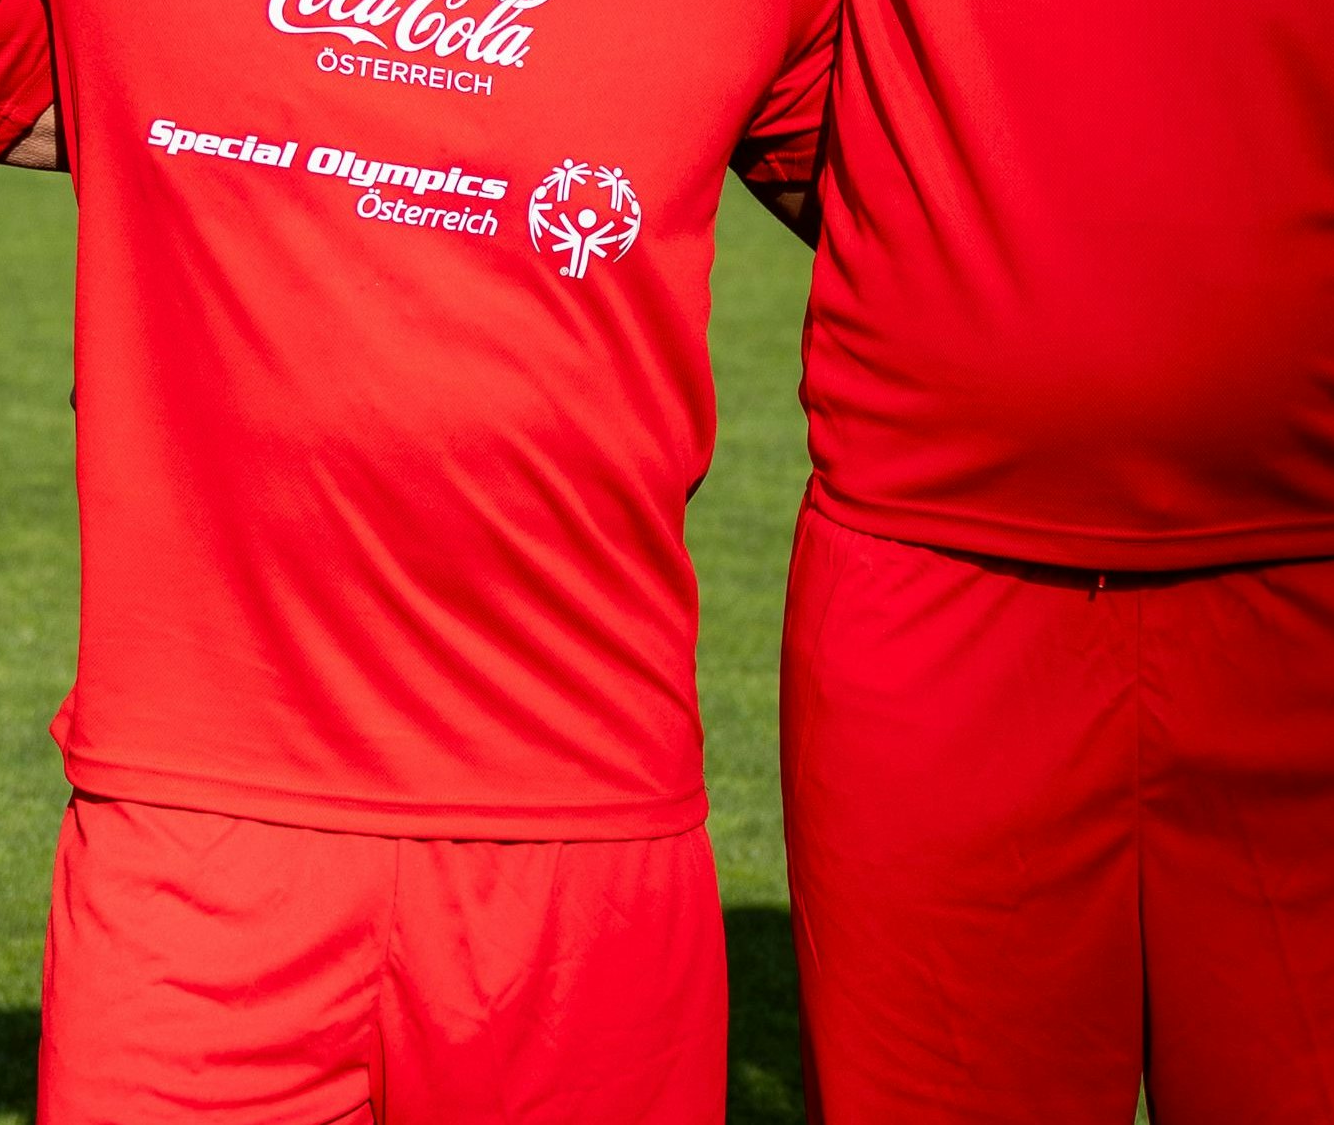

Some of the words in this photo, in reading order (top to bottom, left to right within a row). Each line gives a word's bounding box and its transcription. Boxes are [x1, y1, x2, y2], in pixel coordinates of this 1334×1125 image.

[316, 47, 493, 96] ÖSTERREICH
[147, 118, 298, 168] Special
[306, 146, 508, 201] Olympics
[356, 188, 498, 237] Österreich
